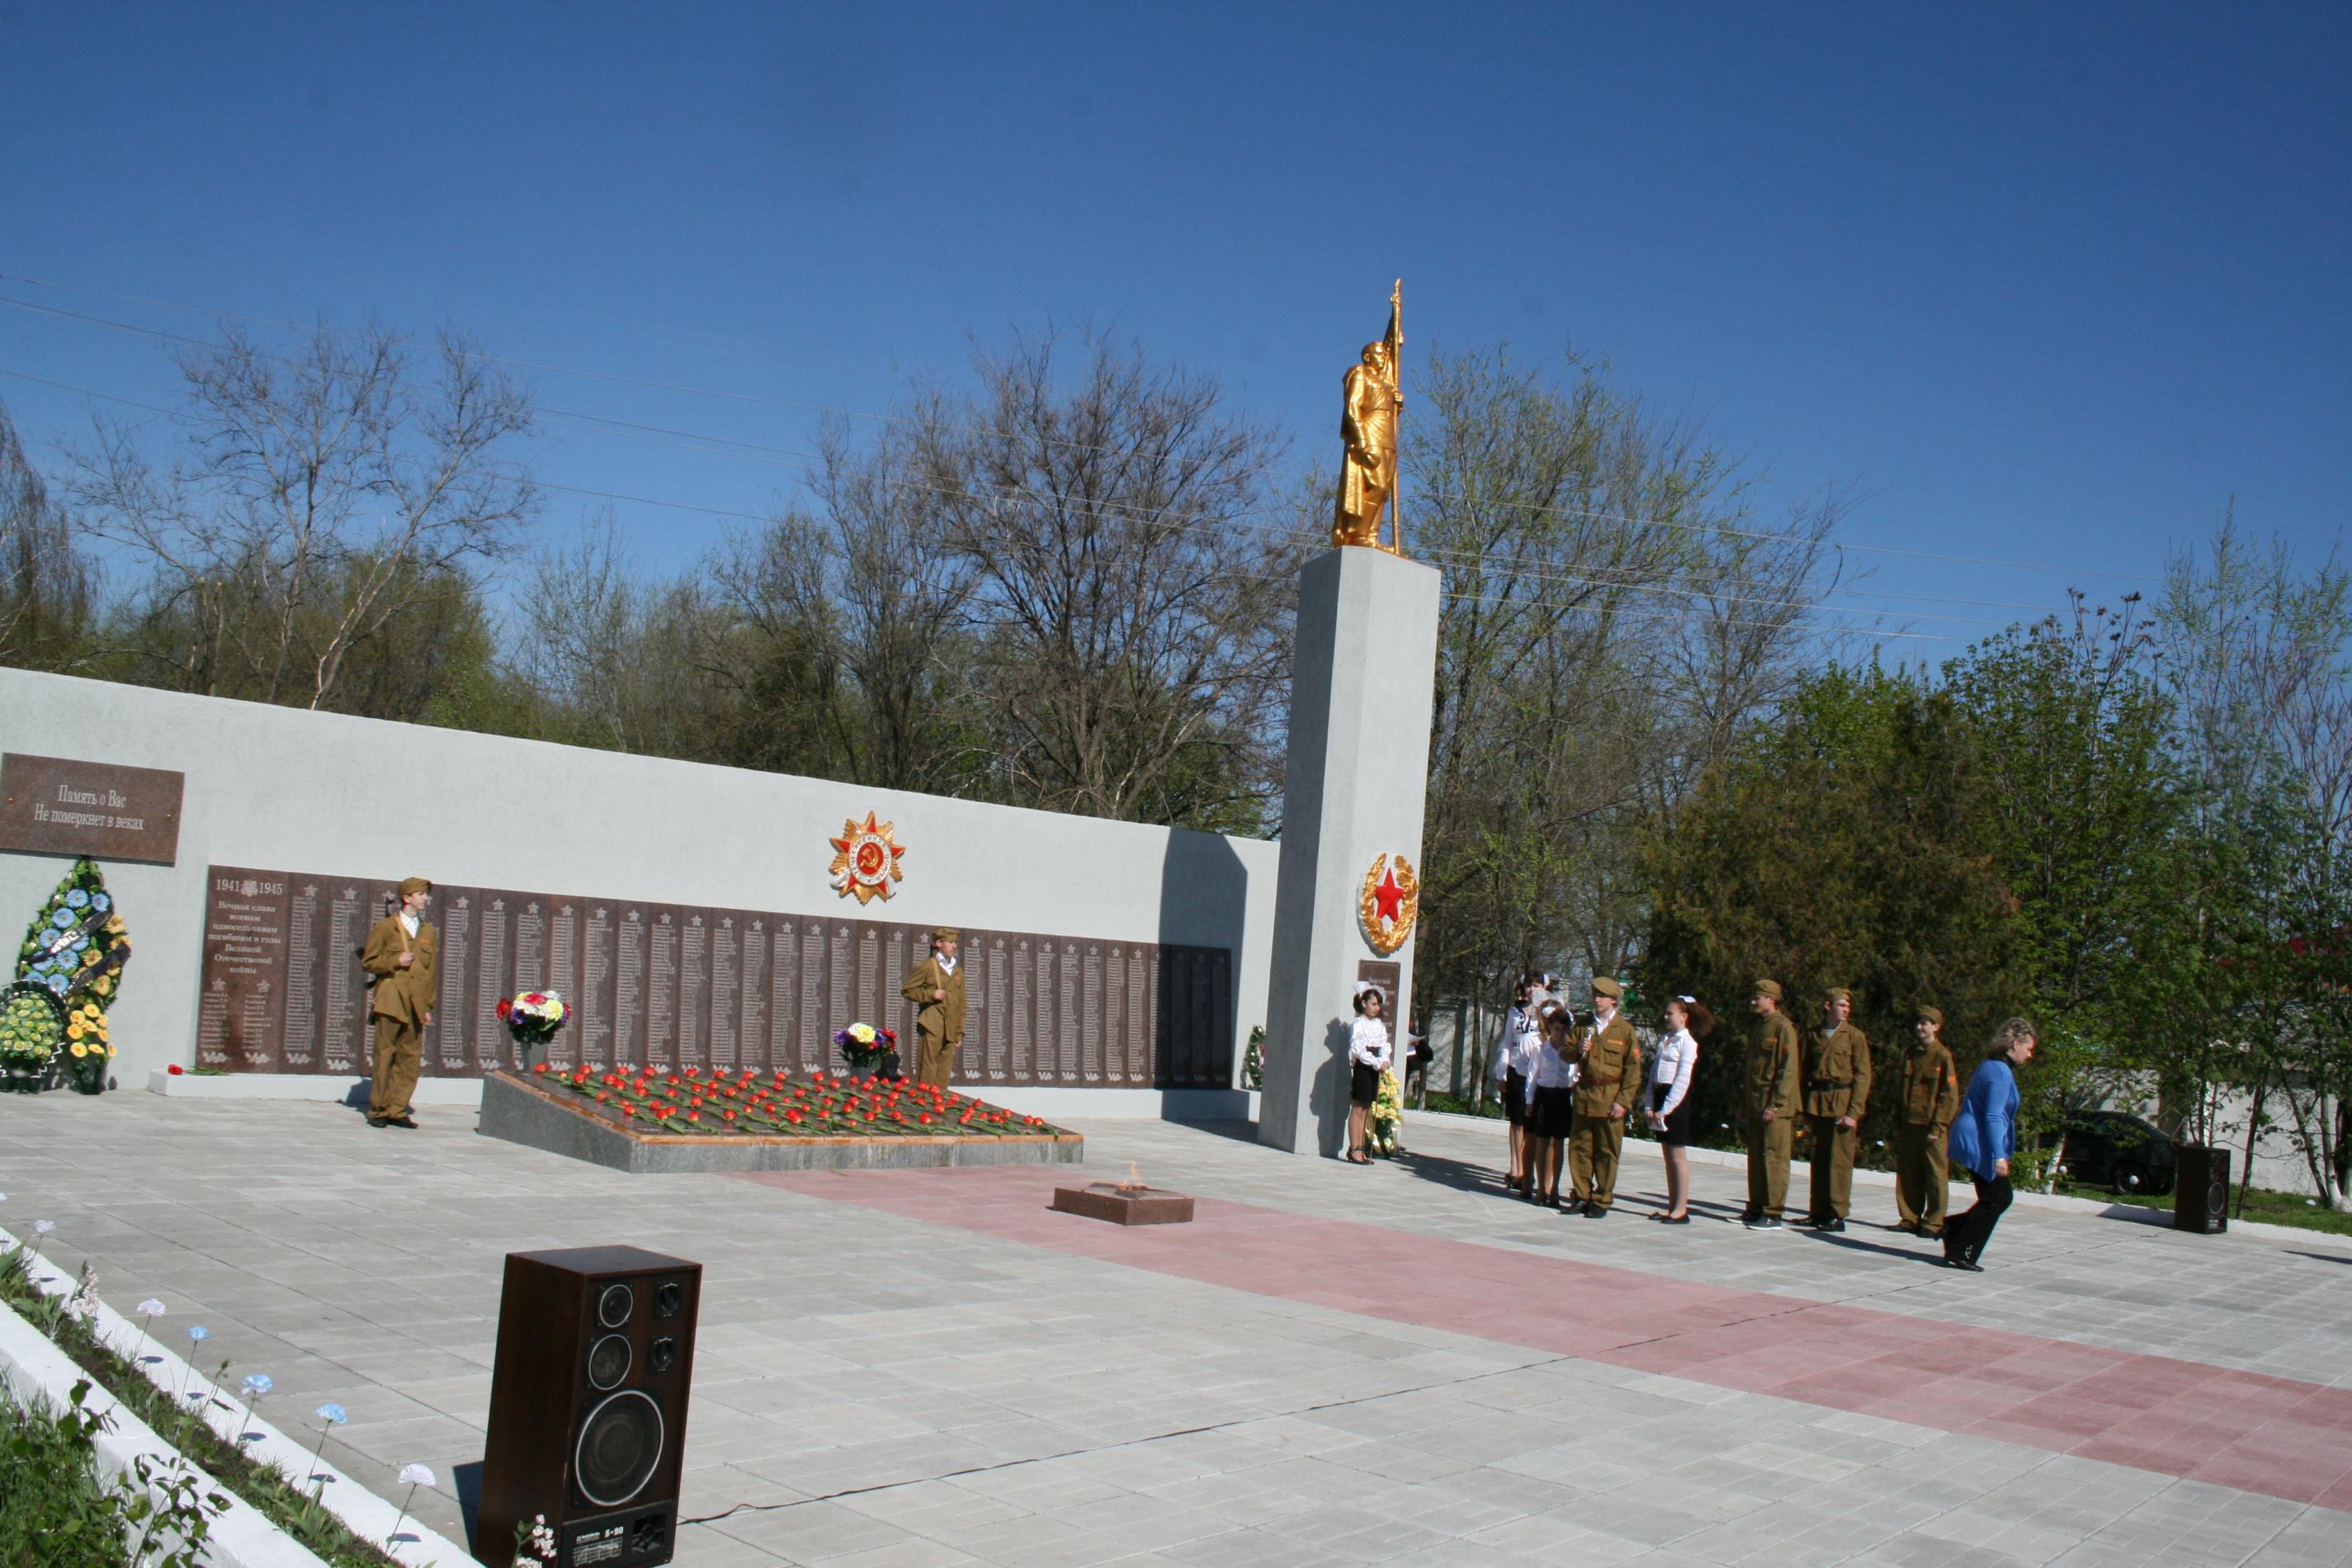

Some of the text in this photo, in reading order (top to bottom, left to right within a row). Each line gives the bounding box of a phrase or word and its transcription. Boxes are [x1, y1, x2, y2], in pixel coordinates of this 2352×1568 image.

[58, 785, 127, 808] Память о Вас
[34, 804, 145, 830] Не померкнет в веках
[216, 879, 283, 895] 1941 1945
